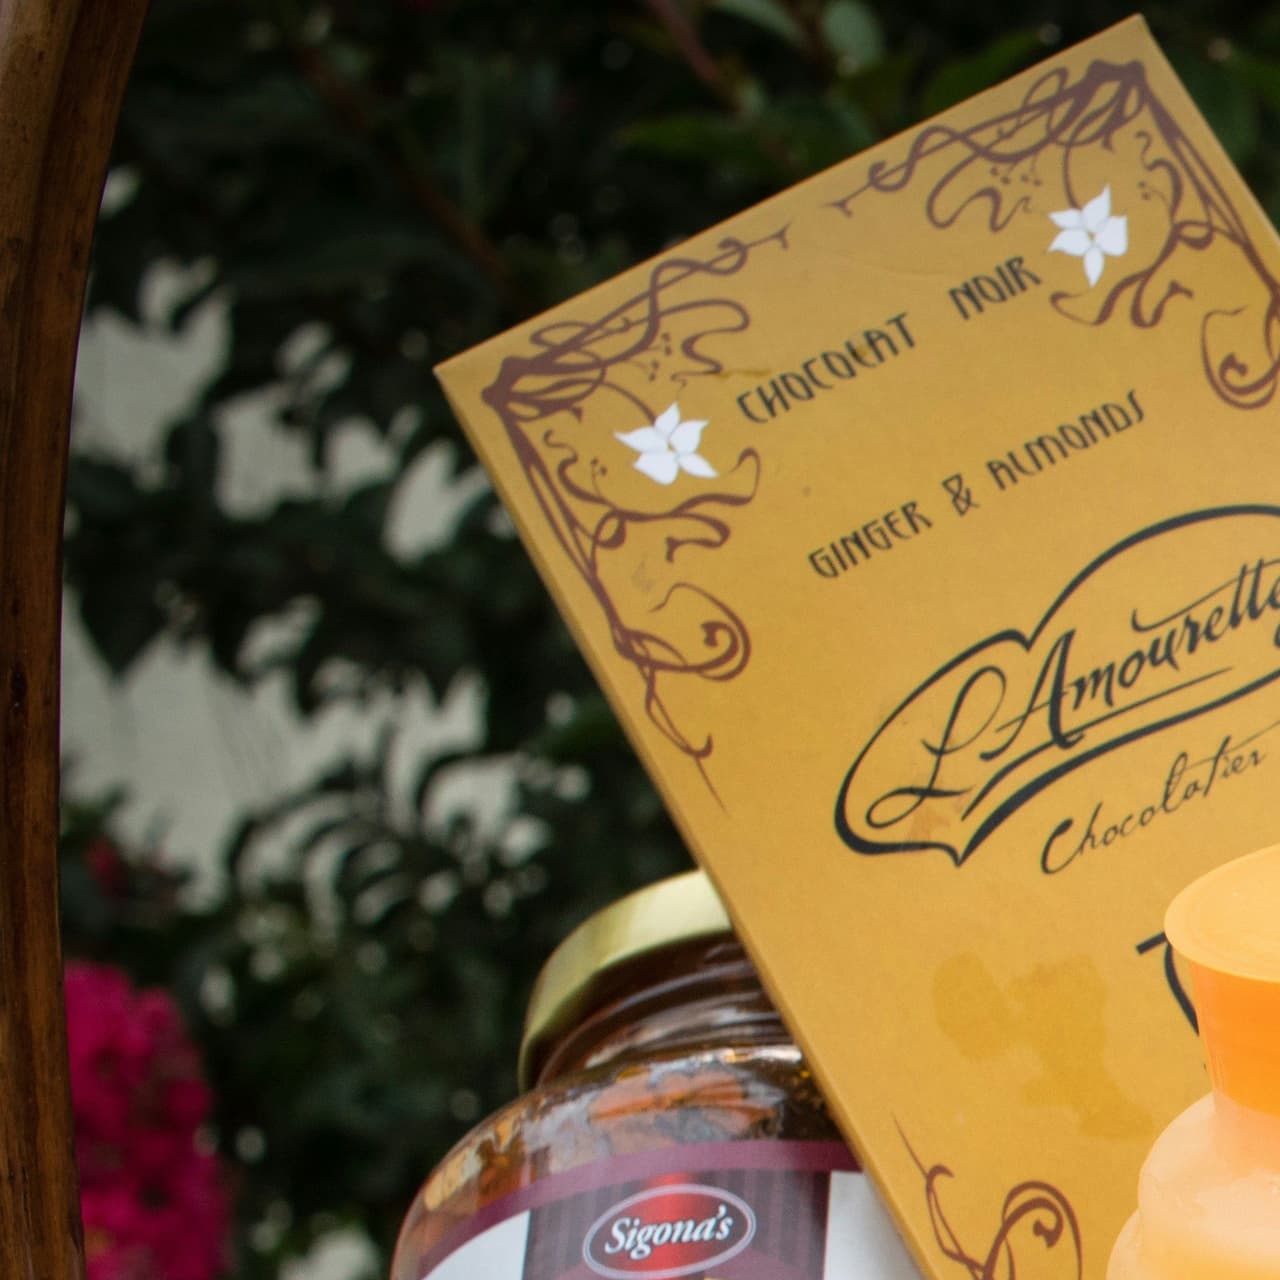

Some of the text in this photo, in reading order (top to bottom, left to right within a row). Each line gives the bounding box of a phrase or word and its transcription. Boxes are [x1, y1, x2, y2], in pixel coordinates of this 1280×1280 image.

[737, 256, 1041, 423] CHOCOLAT NOIR
[808, 389, 1147, 578] GINGER & ALMONDS
[604, 1204, 733, 1260] Sigona's
